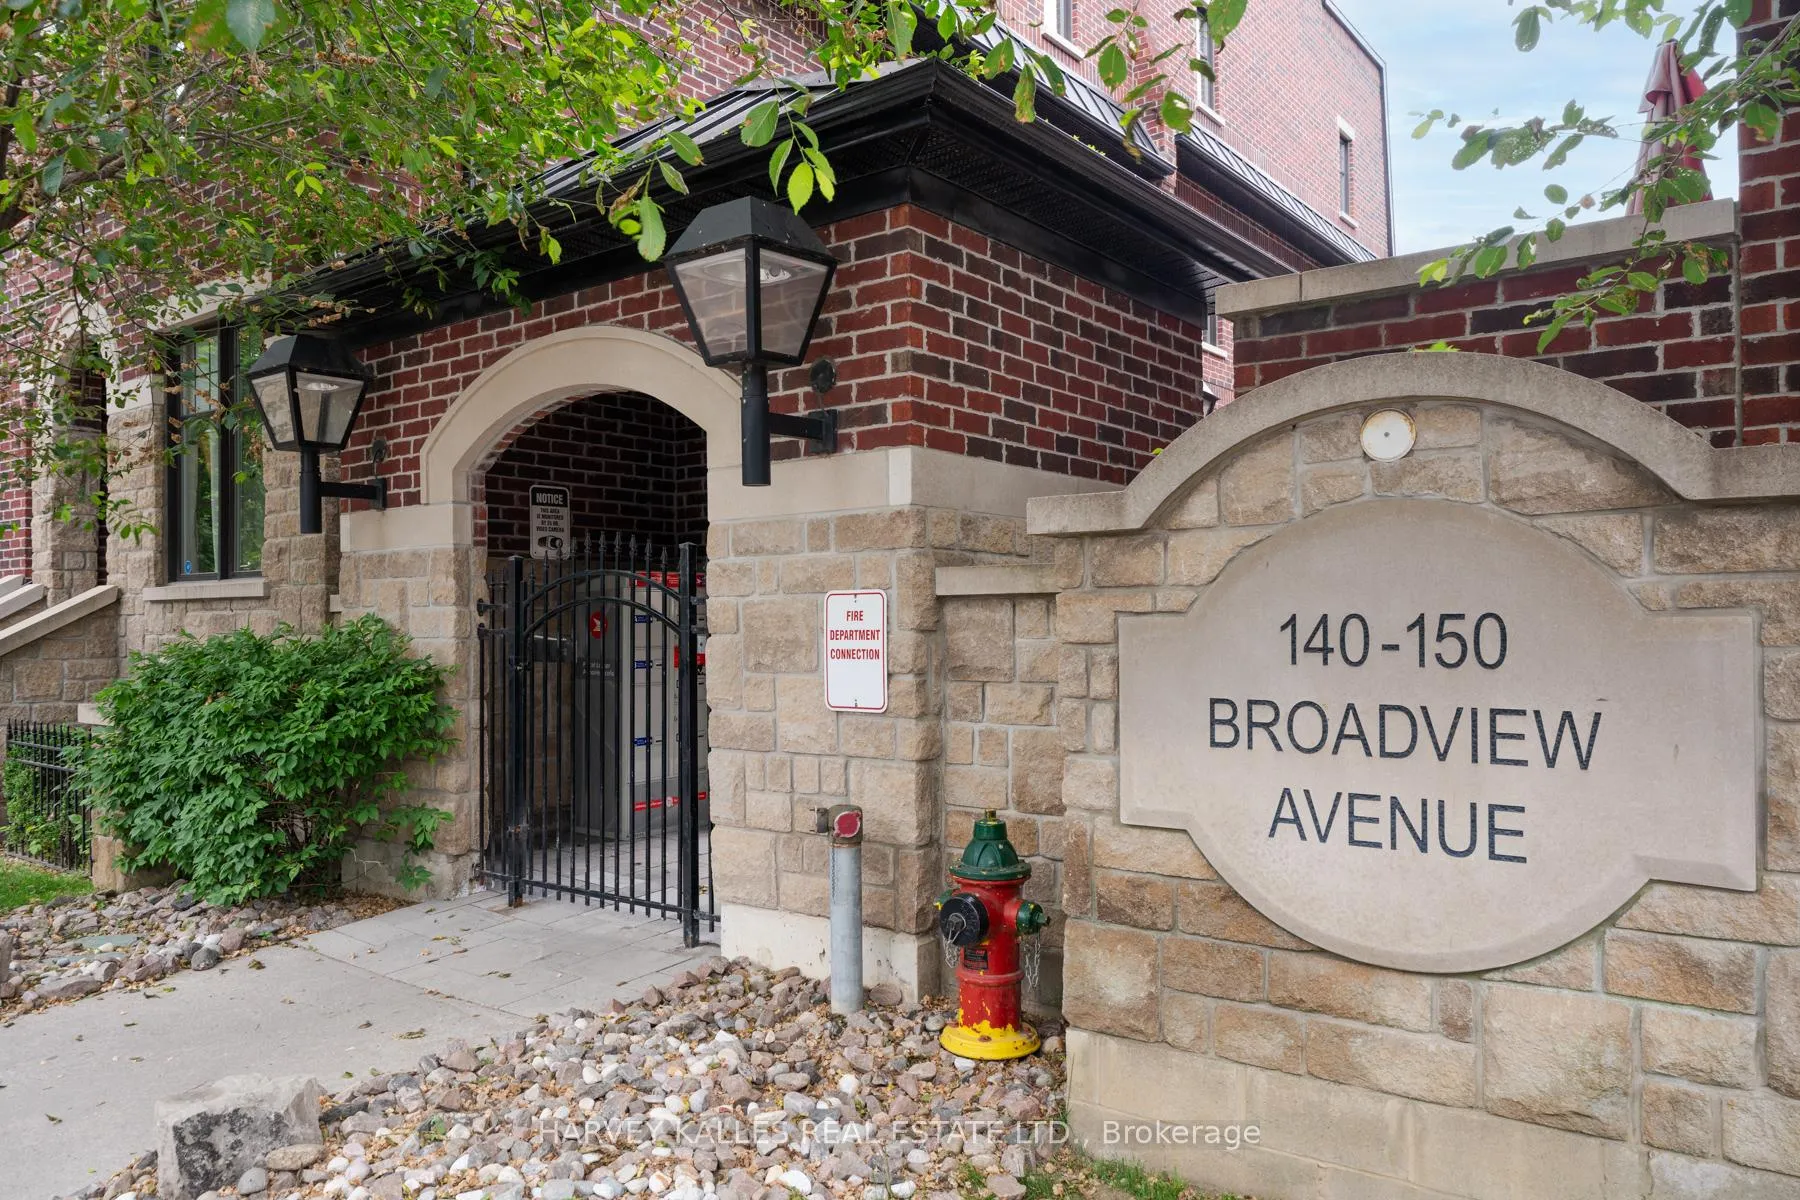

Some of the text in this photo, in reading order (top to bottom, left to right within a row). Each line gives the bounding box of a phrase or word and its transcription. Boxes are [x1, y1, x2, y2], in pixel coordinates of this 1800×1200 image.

[536, 492, 564, 505] NOTICE
[846, 610, 864, 622] FIRE
[829, 629, 881, 641] DEPARTMENT
[1279, 612, 1508, 670] 140-150
[830, 648, 880, 660] CONNECTION
[1208, 697, 1602, 771] BROADVIEW
[1268, 787, 1528, 864] AVENUE
